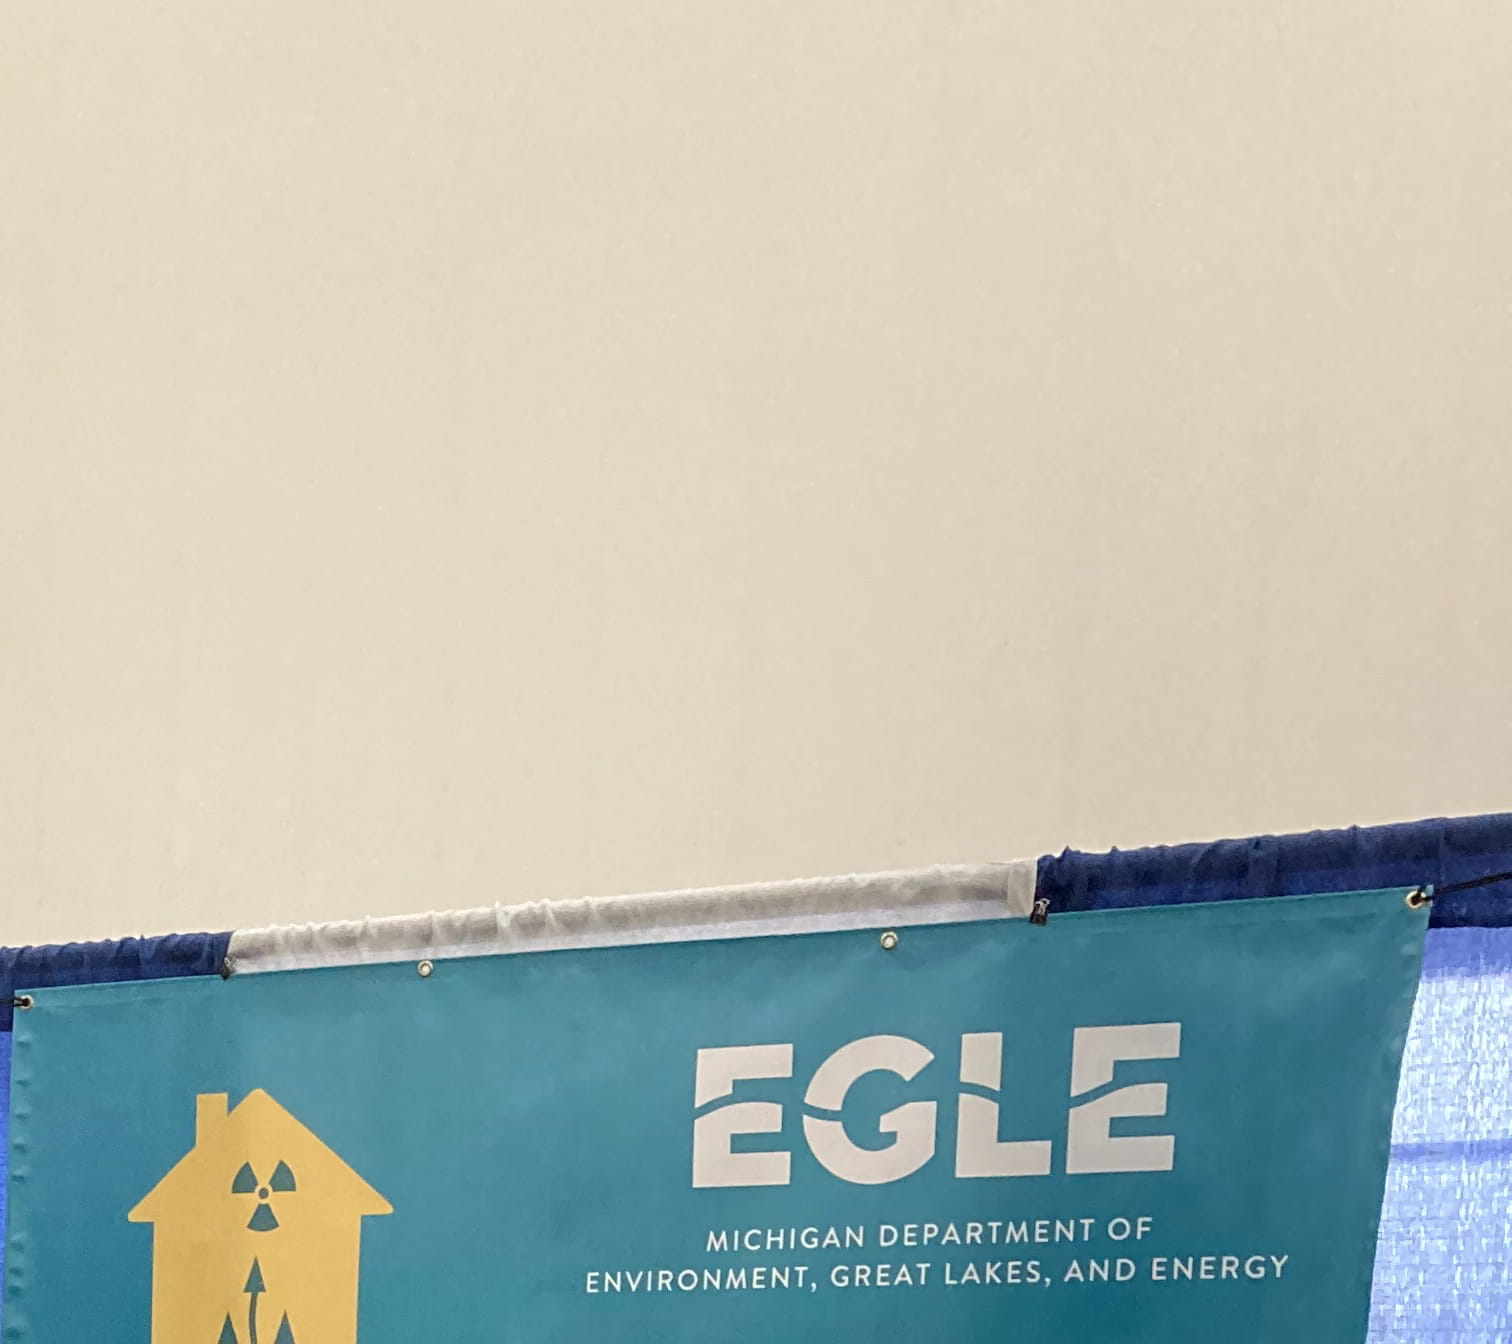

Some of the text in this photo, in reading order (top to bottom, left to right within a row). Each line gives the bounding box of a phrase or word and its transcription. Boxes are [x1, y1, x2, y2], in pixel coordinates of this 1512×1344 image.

[692, 1022, 1181, 1189] EGLE
[706, 1217, 1152, 1252] MICHIGAN DEPARTMENT OF
[586, 1255, 1288, 1293] ENVIRONMENT, GREAT LAKES, AND ENERGY
